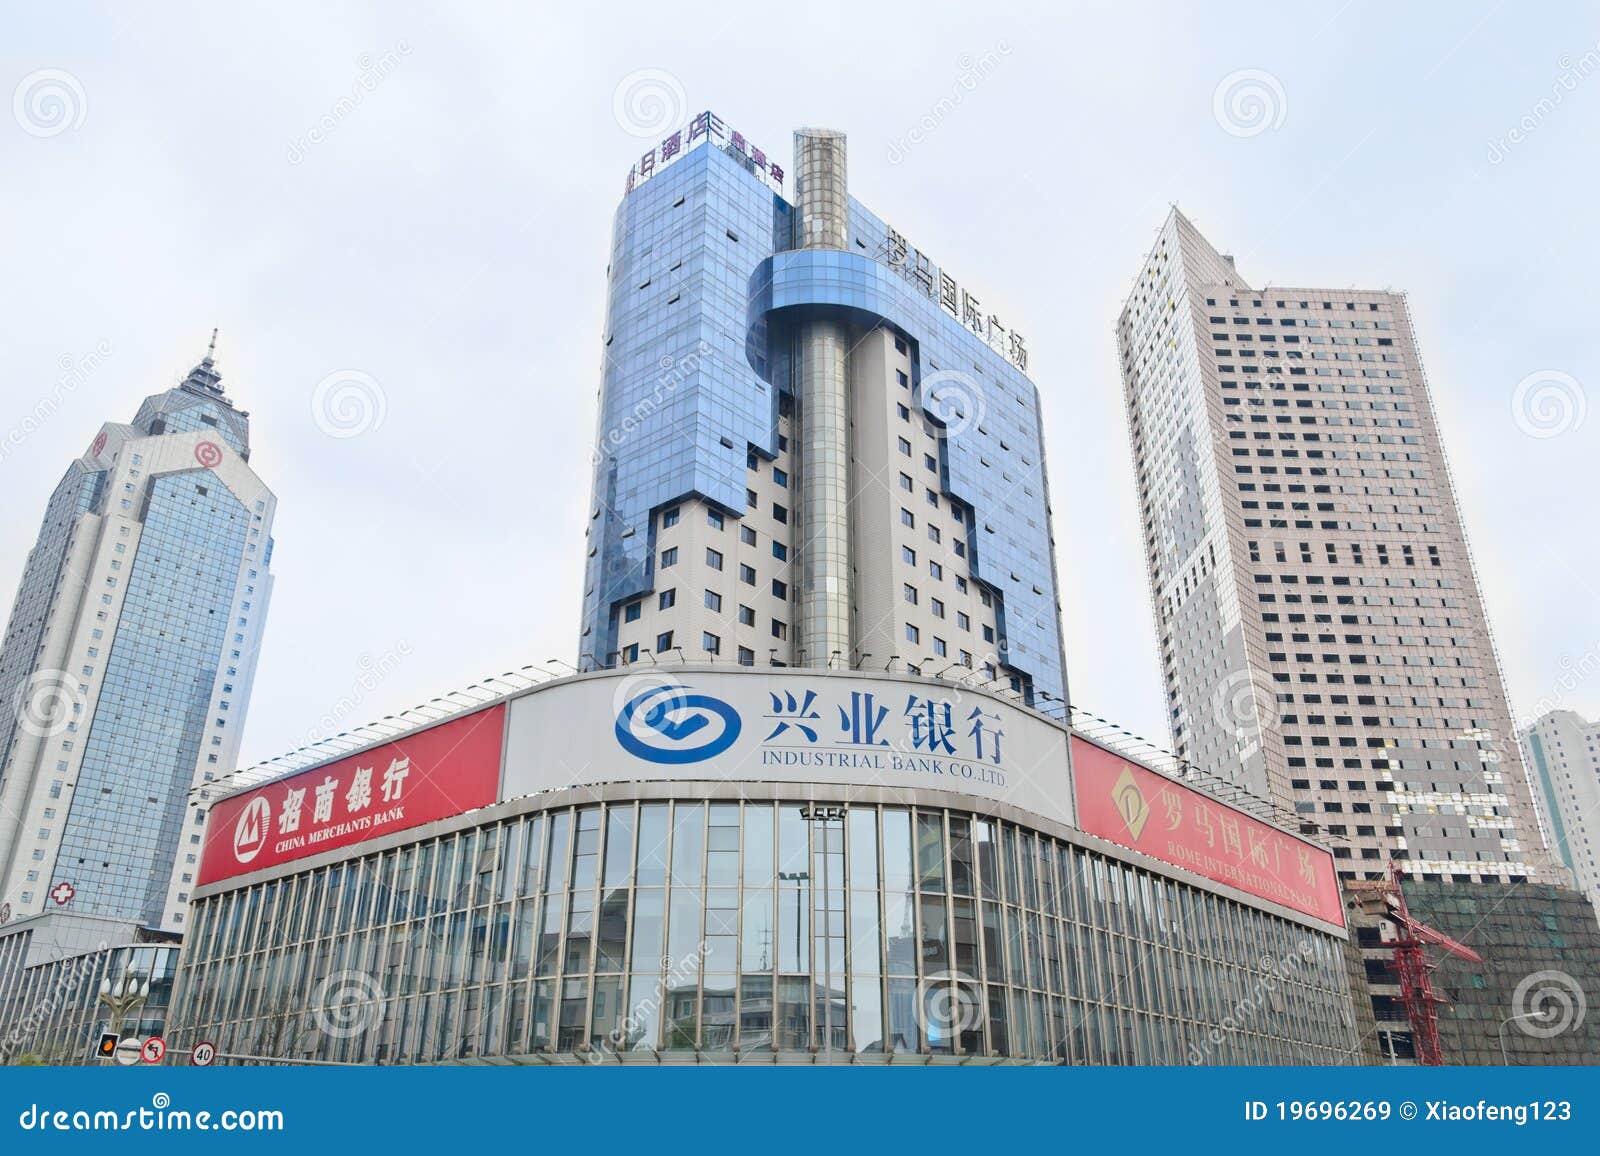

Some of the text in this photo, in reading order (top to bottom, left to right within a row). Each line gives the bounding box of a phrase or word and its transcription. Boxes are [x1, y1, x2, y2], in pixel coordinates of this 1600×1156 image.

[887, 224, 1028, 371] 罗马国际广场
[763, 690, 1004, 764] 兴业银行
[763, 751, 885, 769] INDUSTRIAL
[893, 757, 943, 774] BANK
[275, 807, 405, 854] CHINA MERCHANTS BANK
[1161, 789, 1316, 888] 罗马国际广场
[1167, 841, 1201, 866] ROME
[196, 1048, 211, 1061] 40
